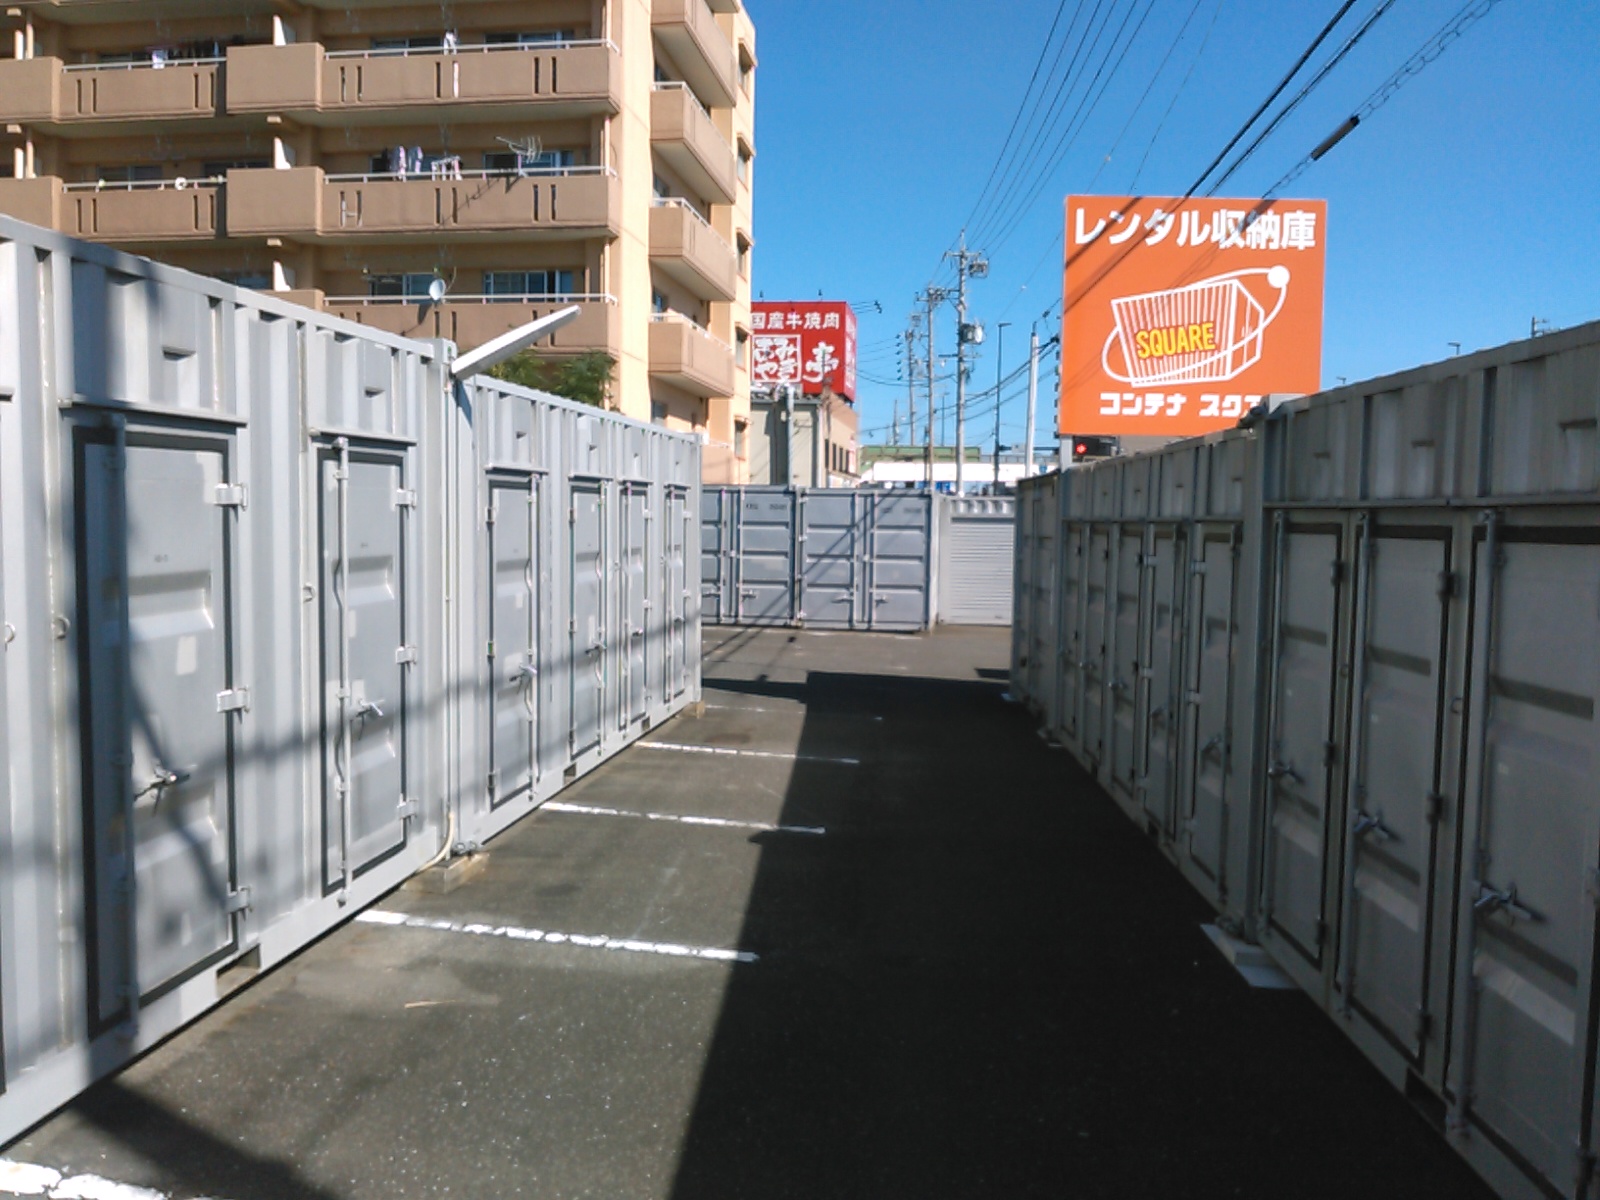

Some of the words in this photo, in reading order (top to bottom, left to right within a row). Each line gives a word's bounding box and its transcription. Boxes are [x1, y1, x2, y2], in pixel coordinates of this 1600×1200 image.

[1074, 207, 1317, 250] レンタル収納庫
[752, 312, 839, 329] 国産牛焼肉
[1135, 321, 1216, 360] SQUARE
[1099, 392, 1187, 417] コンテナ
